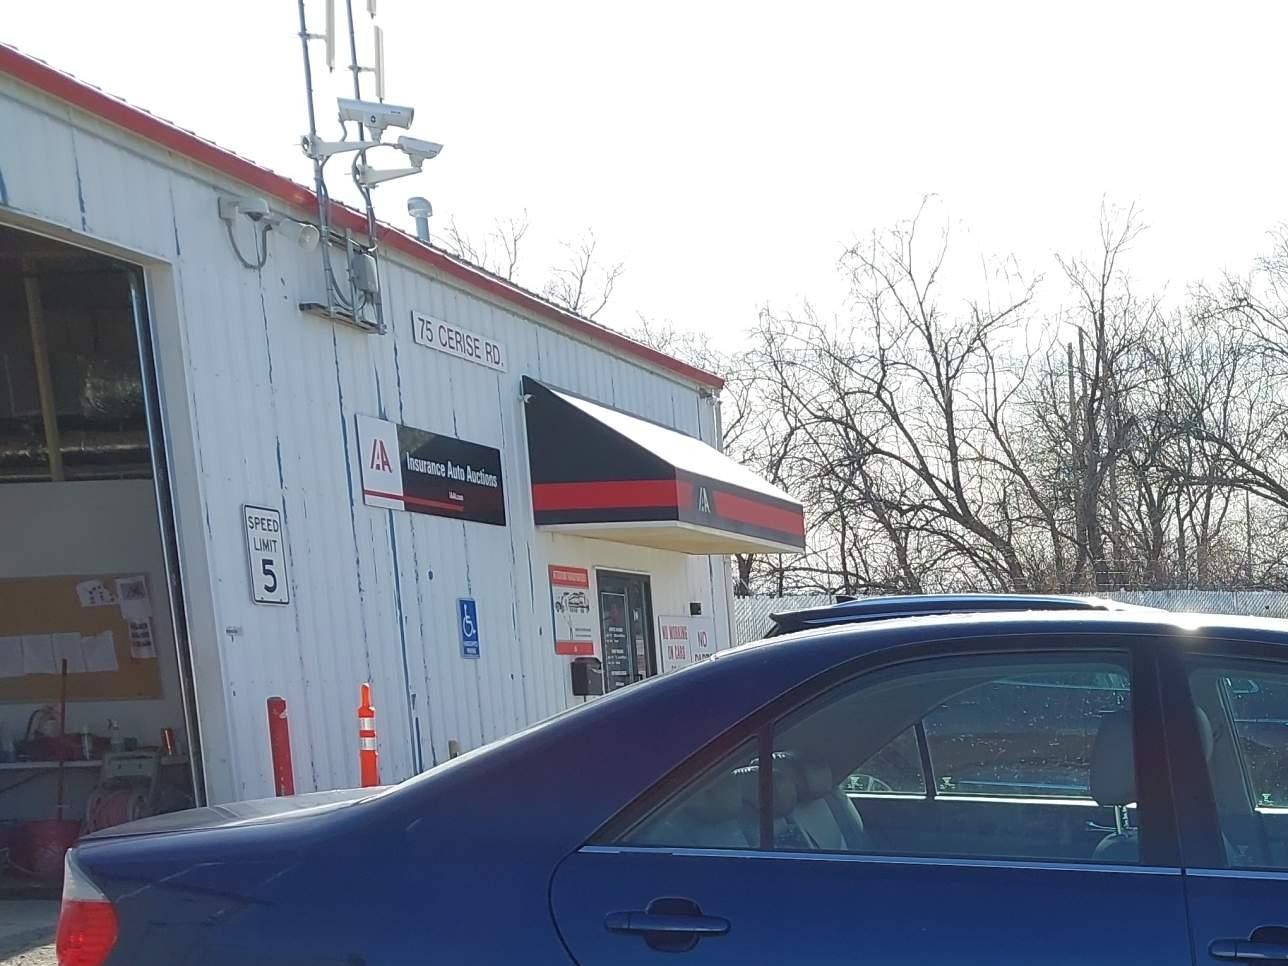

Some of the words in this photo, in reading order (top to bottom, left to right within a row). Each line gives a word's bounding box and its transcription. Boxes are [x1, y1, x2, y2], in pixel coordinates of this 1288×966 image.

[418, 317, 434, 342] 75
[438, 325, 481, 359] CERISE
[485, 342, 504, 366] RD.
[406, 451, 446, 477] Insurance
[447, 460, 465, 481] Auto
[466, 465, 498, 488] Auctions
[248, 515, 279, 532] SPEED
[253, 536, 278, 553] LIMIT
[261, 558, 277, 593] 5
[697, 631, 708, 648] NO
